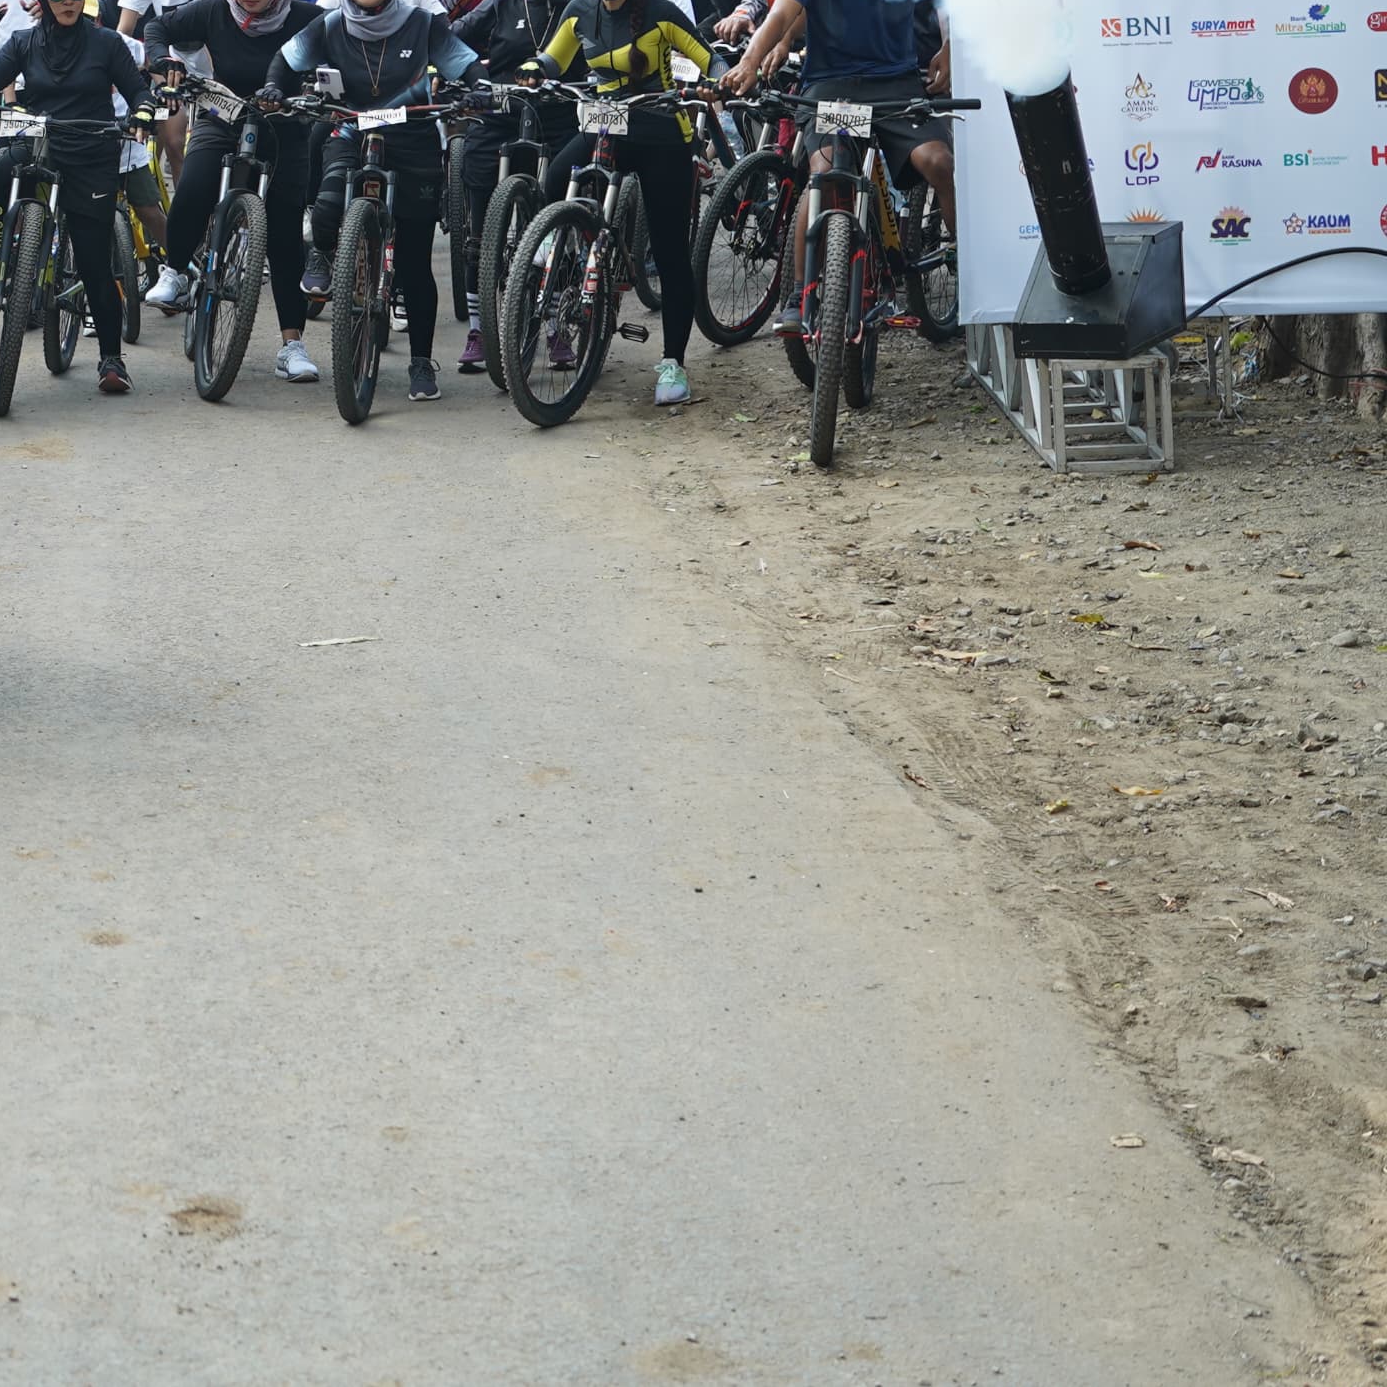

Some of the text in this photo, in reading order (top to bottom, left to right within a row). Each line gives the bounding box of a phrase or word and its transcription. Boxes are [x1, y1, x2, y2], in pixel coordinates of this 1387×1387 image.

[1126, 16, 1171, 37] BNI
[1275, 21, 1347, 32] Mitra Syariah
[1222, 159, 1263, 168] RASUNA
[1283, 153, 1309, 167] BSI
[1125, 176, 1160, 186] LDP
[1210, 217, 1251, 238] SAC
[1307, 214, 1351, 228] KAUM
